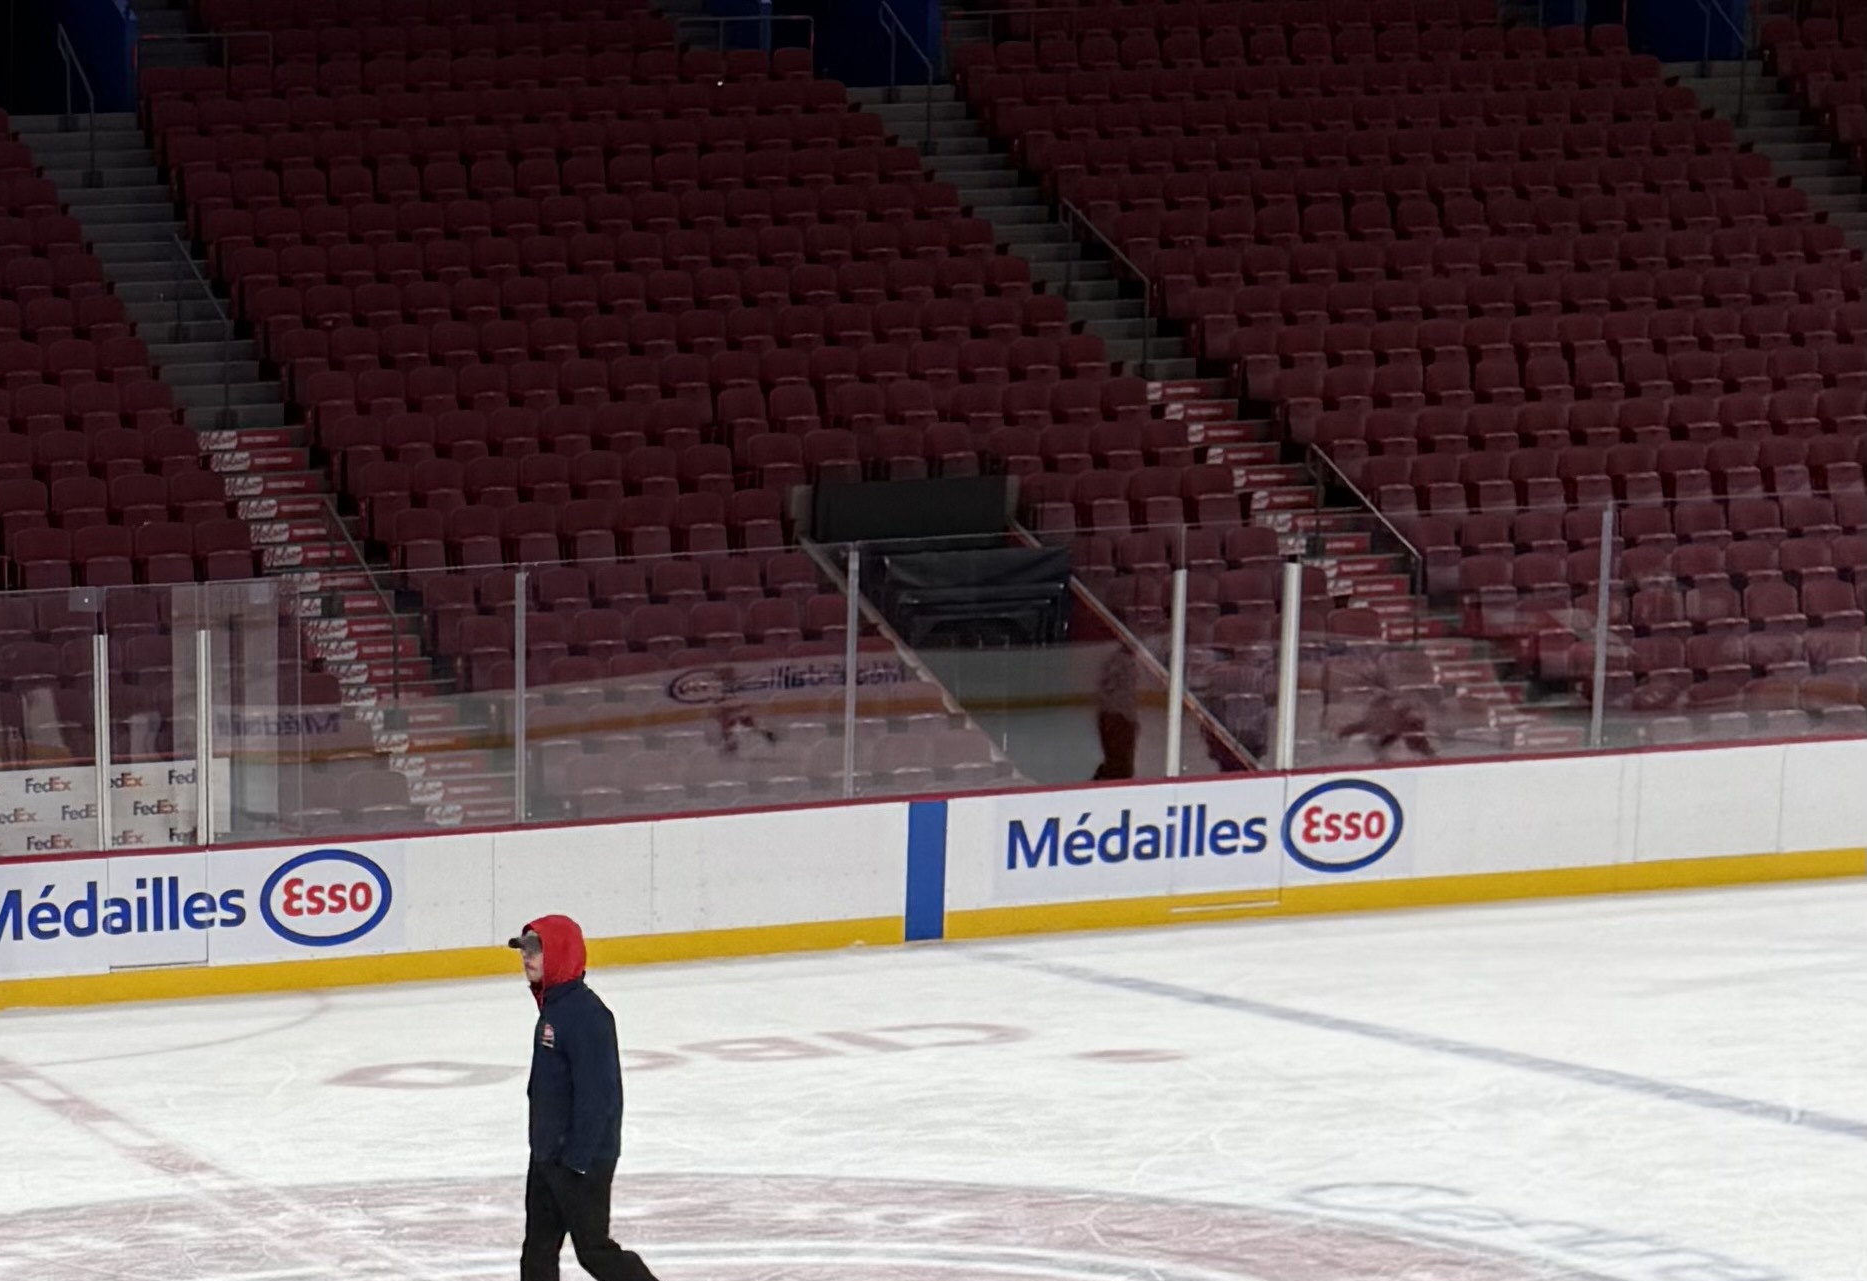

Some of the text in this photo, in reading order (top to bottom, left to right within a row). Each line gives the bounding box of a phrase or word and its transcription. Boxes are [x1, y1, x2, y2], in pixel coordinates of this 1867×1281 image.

[25, 776, 72, 794] FedEx
[168, 768, 197, 784] Fed
[61, 804, 97, 821] FedE
[134, 798, 179, 816] FedEx
[27, 834, 74, 851] FedEx
[1007, 805, 1385, 870] Médailles Esso
[283, 878, 372, 917] Esso
